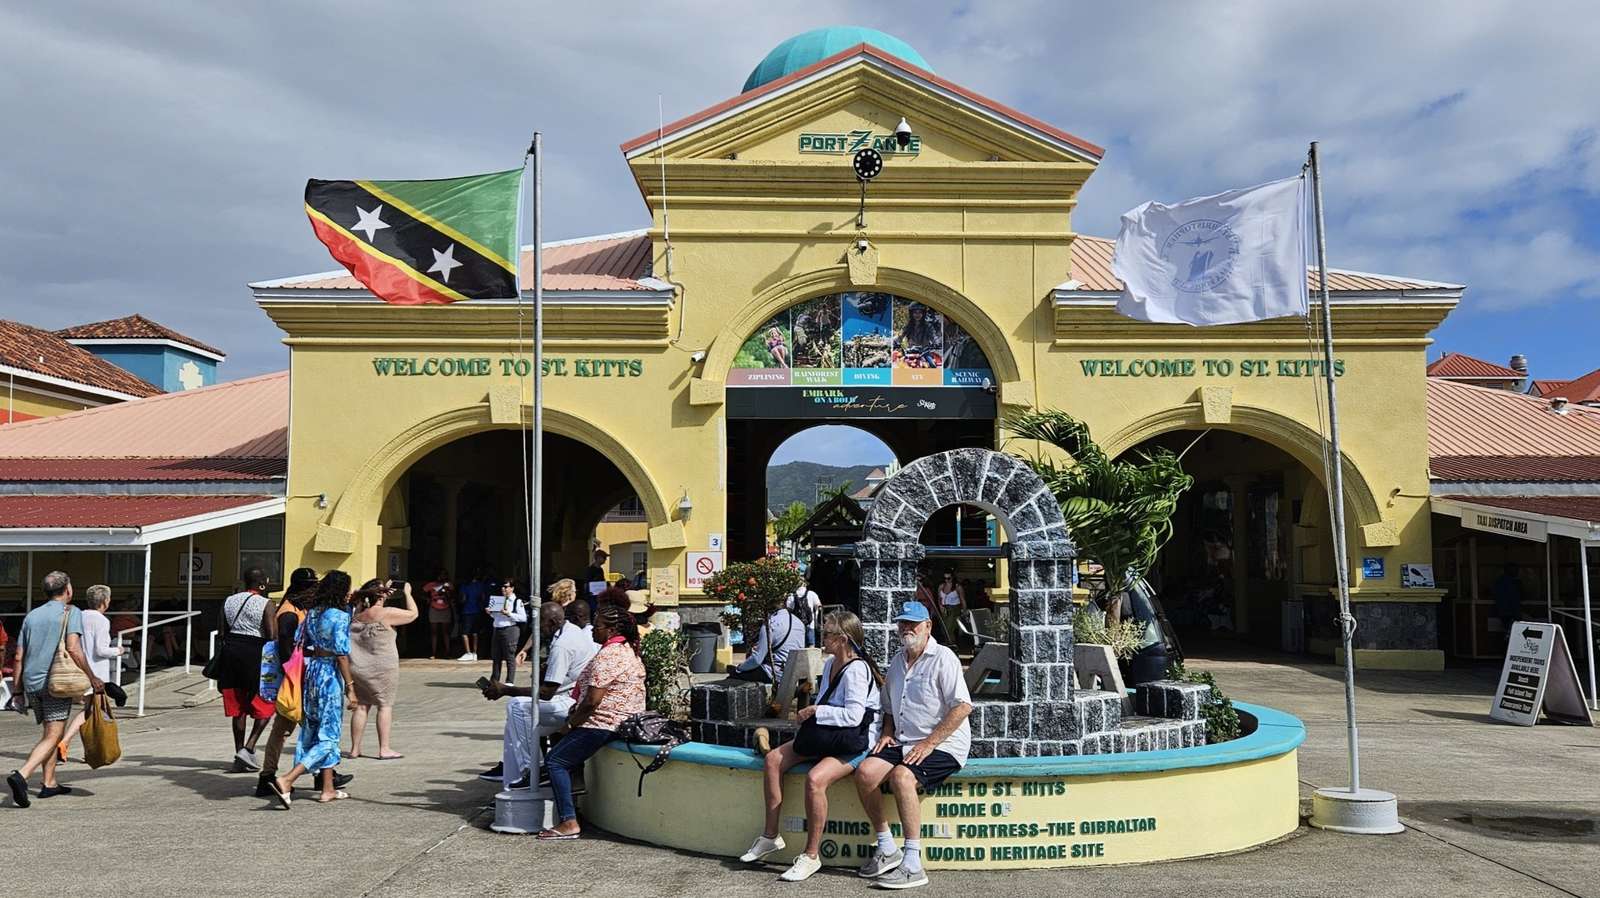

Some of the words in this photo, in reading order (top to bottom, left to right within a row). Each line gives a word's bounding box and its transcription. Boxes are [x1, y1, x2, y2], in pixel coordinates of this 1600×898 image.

[800, 136, 848, 151] PORT
[373, 357, 491, 376] WELCOME
[500, 358, 532, 376] TO
[574, 358, 643, 377] KITTS
[1080, 359, 1195, 377] WELCOME
[1203, 359, 1233, 377] TO
[1241, 359, 1269, 377] ST.
[1276, 359, 1345, 378] KITTS
[802, 389, 844, 397] EMBARK
[832, 395, 908, 412] adventure
[1477, 514, 1488, 527] TAXI
[1488, 516, 1514, 532] DISPATCH
[1513, 521, 1528, 534] AREA
[712, 538, 719, 546] 3
[968, 782, 987, 797] TO
[1021, 781, 1066, 797] KITTS
[935, 803, 986, 817] HOME
[1079, 817, 1157, 835] GIBRALTAR
[841, 844, 851, 857] A
[926, 846, 985, 861] WORLD
[990, 844, 1066, 861] HERITAGE
[1071, 843, 1105, 858] SITE
